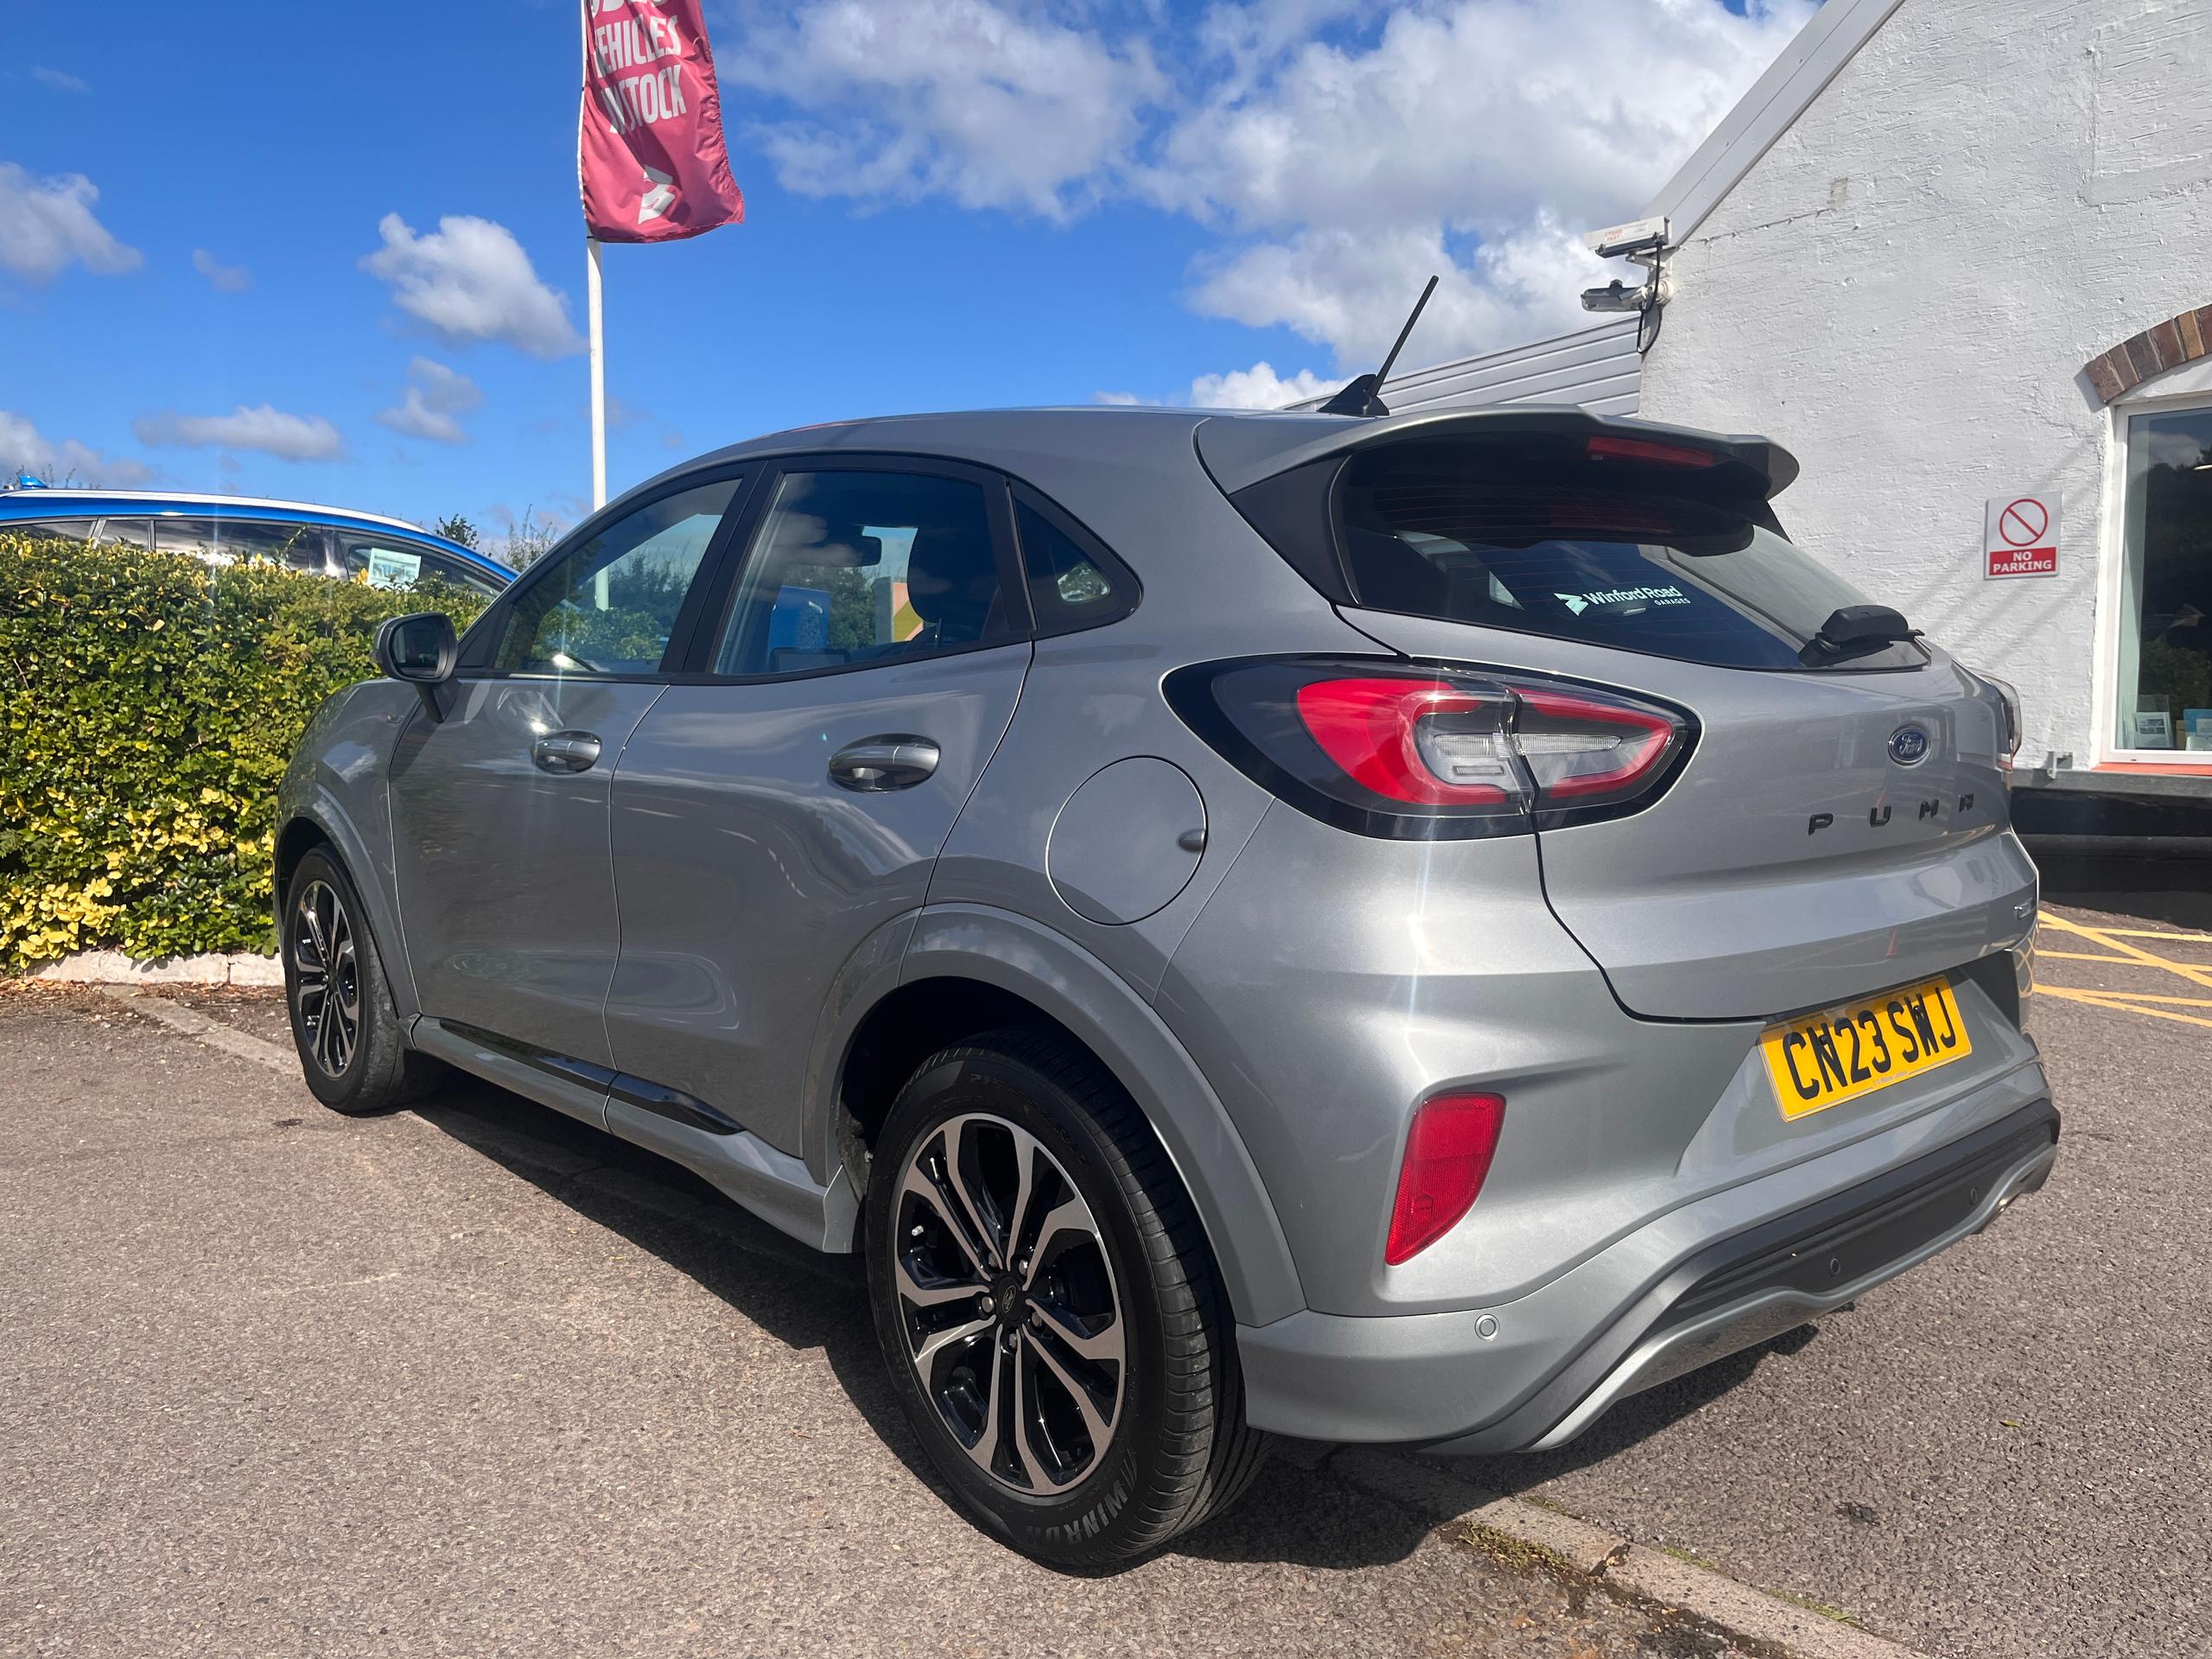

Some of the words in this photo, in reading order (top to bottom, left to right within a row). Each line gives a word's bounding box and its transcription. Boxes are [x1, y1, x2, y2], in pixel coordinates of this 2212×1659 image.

[2012, 550, 2032, 562] NO
[1993, 559, 2053, 574] PARKING
[1582, 587, 1648, 605] Winford
[1641, 585, 1683, 599] Road
[1654, 597, 1692, 607] GARAGES
[1808, 792, 1975, 836] PUMA
[1782, 1009, 1892, 1101] CN23
[1886, 987, 1957, 1064] SWJ
